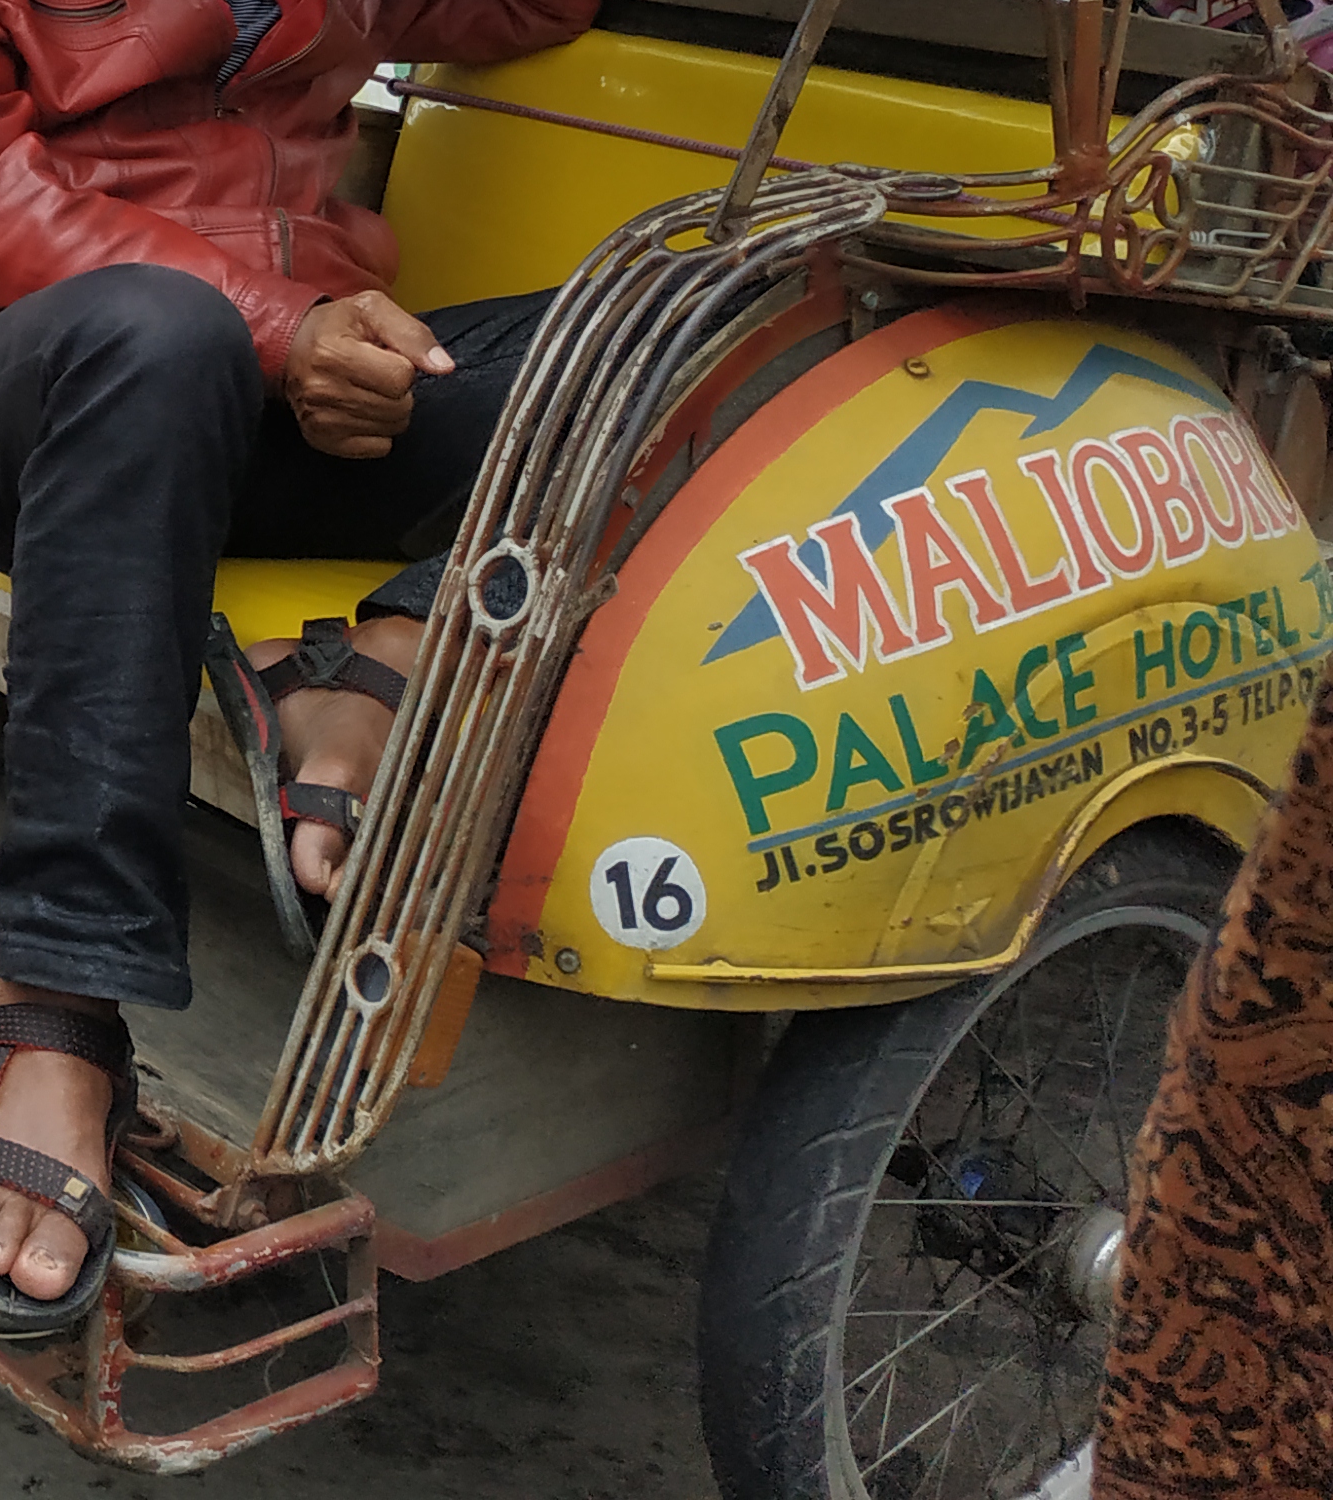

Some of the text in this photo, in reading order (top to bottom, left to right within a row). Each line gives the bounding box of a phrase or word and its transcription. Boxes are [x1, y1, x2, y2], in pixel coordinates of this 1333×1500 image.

[713, 632, 1098, 836] PALACE
[1134, 585, 1300, 700] HOTEL
[605, 854, 694, 932] 16
